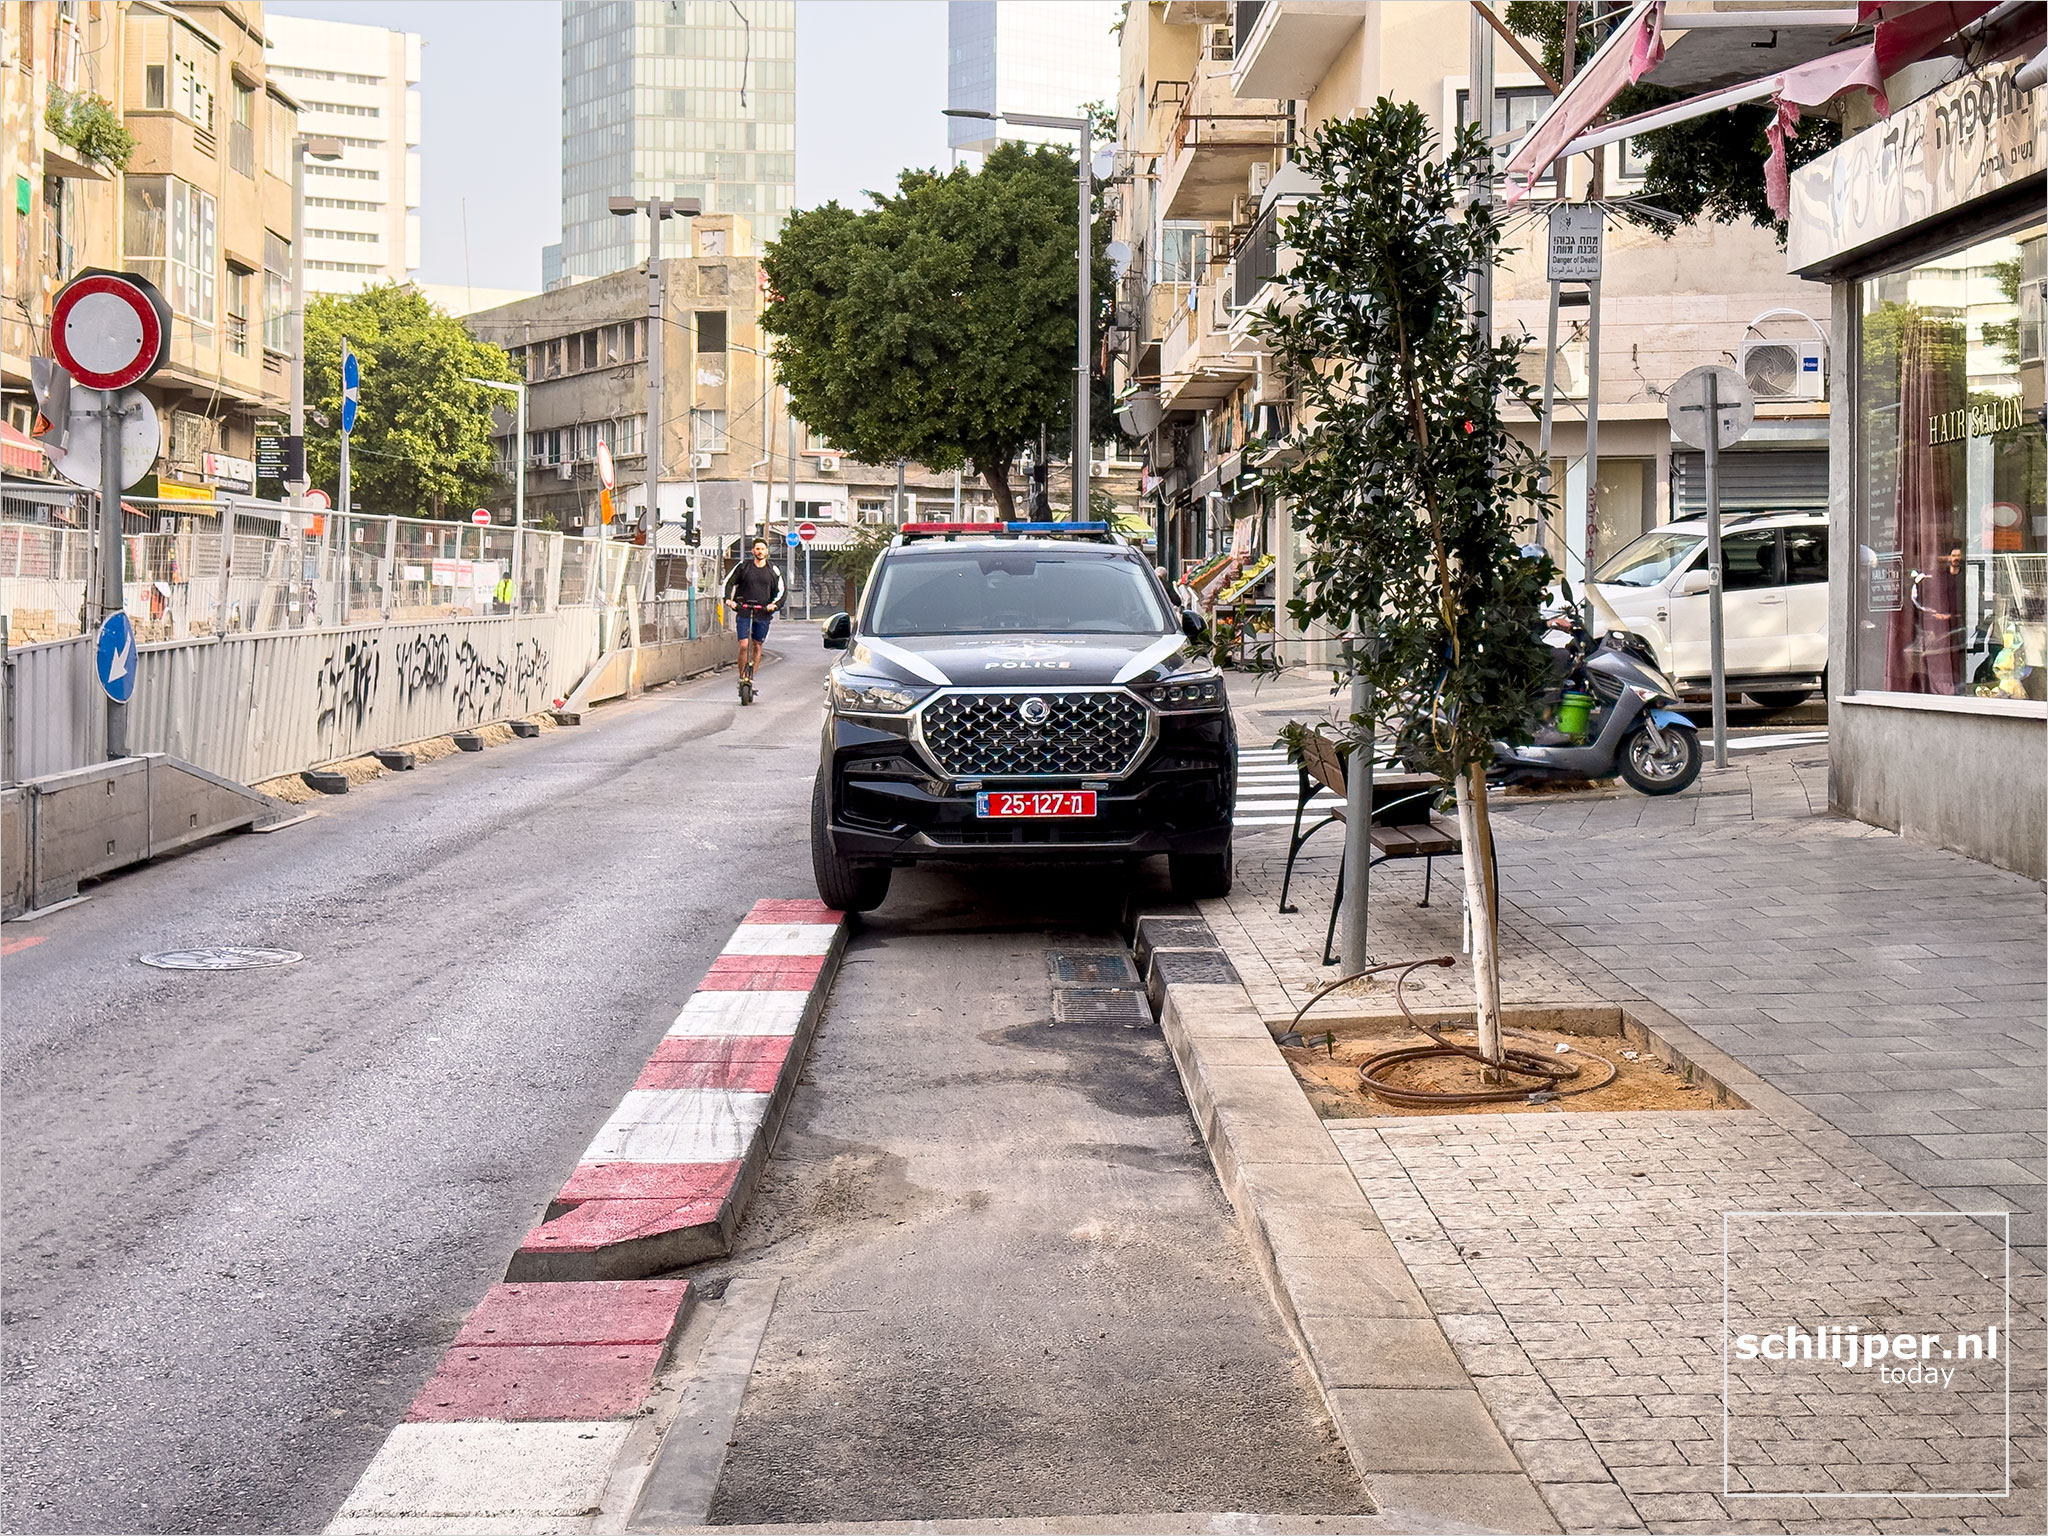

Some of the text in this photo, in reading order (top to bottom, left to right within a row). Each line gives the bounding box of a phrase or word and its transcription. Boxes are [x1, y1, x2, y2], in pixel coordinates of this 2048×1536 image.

[1981, 141, 2033, 178] נשים גברים
[1580, 236, 1598, 245] מתח
[1577, 245, 1598, 254] סכנת
[1552, 256, 1572, 265] Danger
[1929, 395, 2025, 446] HAIR SALON
[985, 661, 1071, 671] POLICE
